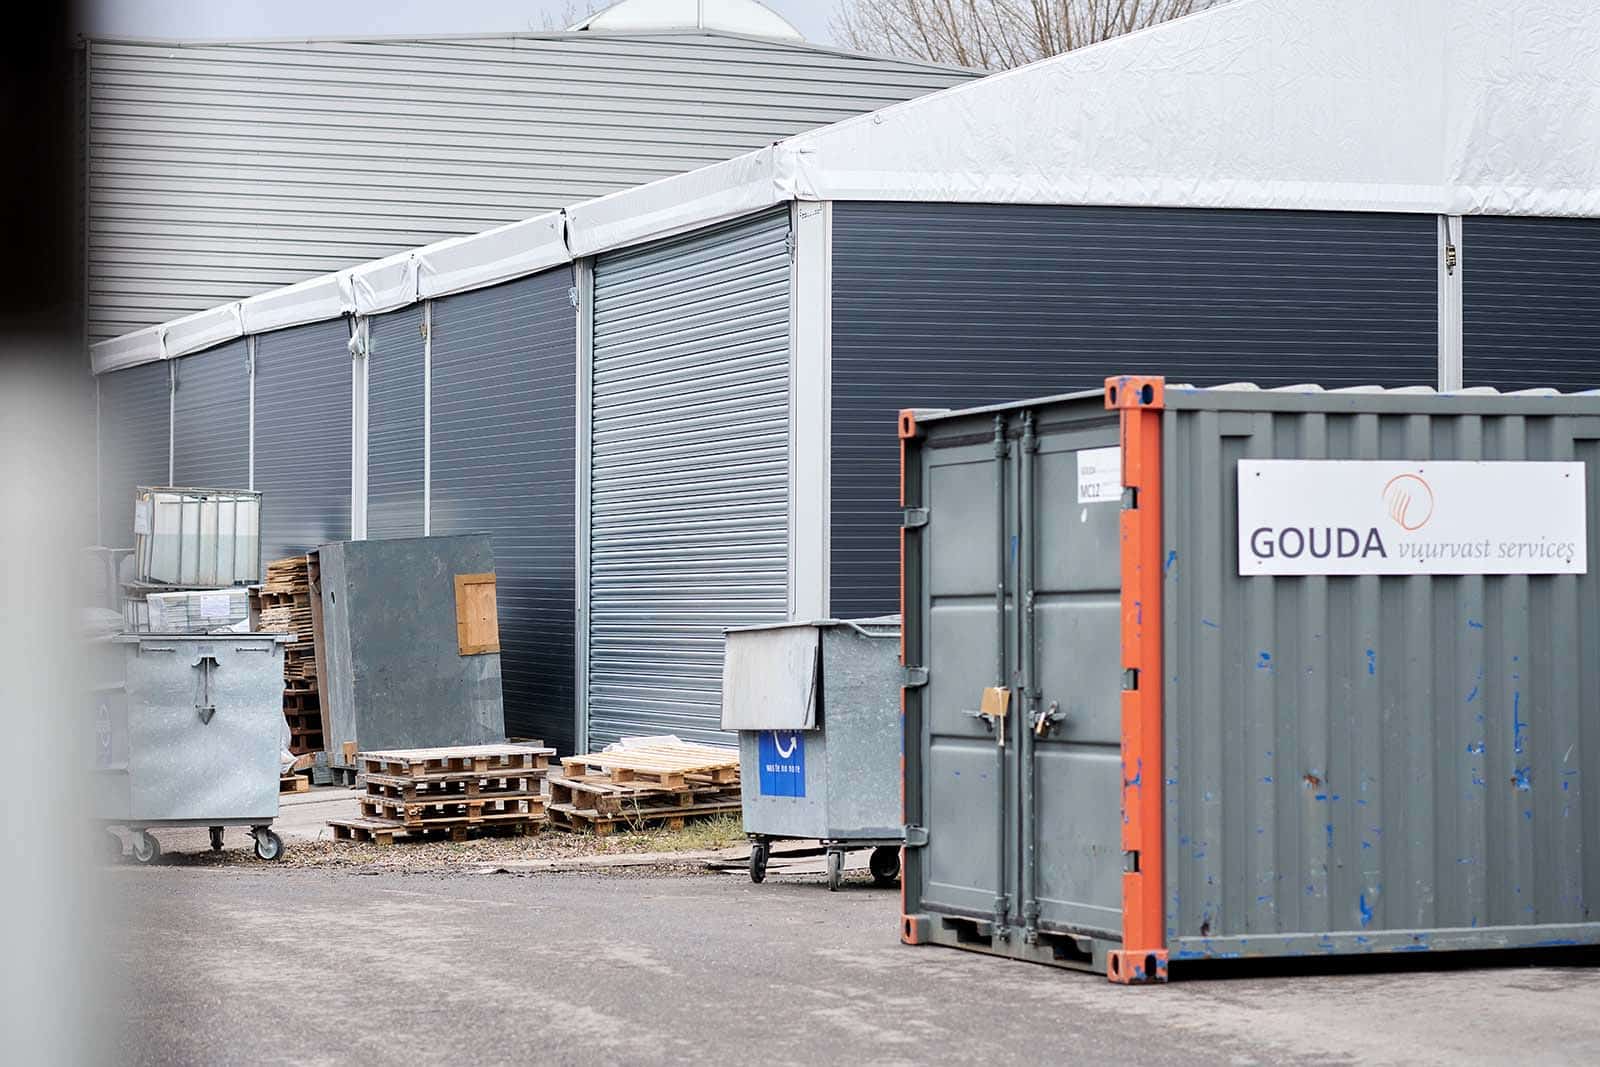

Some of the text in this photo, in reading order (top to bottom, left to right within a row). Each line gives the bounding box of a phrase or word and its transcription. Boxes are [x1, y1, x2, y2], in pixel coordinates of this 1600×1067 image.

[1250, 527, 1576, 560] GOUDA vuurvast services
